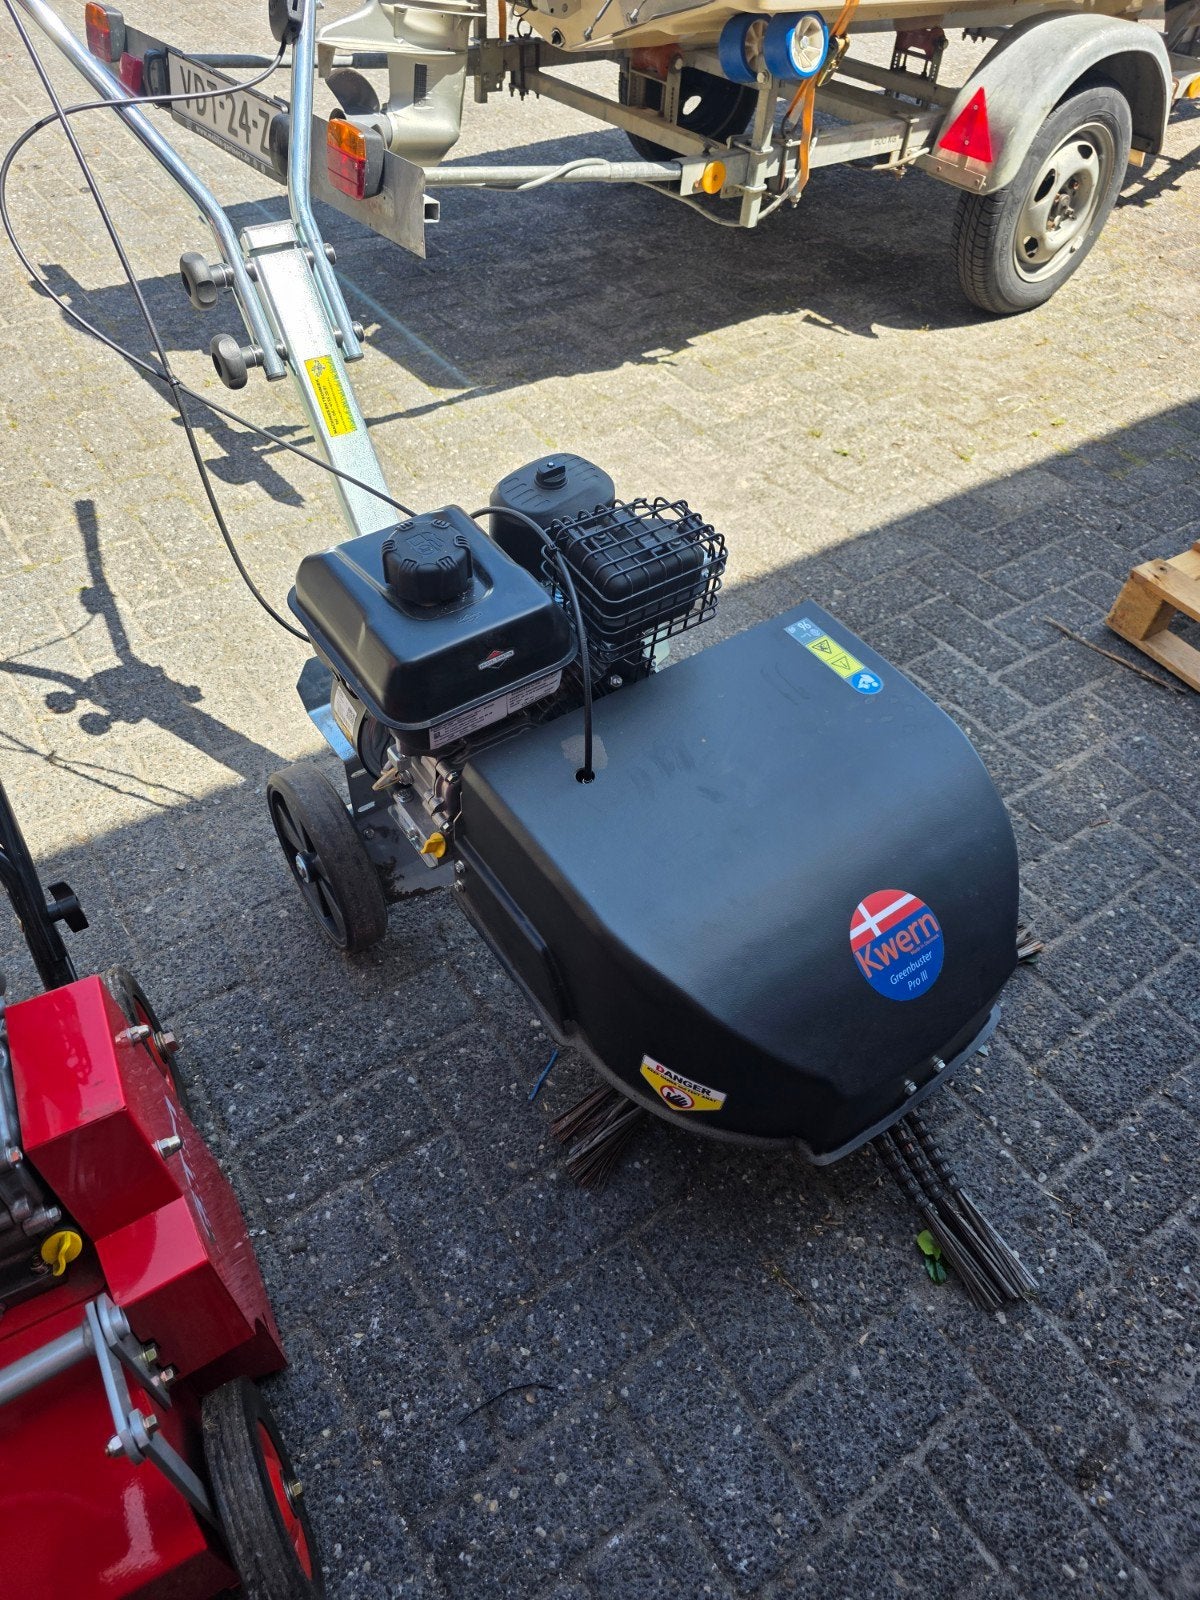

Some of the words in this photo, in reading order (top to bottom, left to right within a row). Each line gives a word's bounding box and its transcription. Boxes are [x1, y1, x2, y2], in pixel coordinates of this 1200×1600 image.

[180, 65, 271, 156] VDT-24-Z
[855, 913, 939, 979] Kwern
[889, 950, 933, 985] Greenbuster
[907, 977, 921, 990] Pro
[656, 1065, 711, 1096] DANGER
